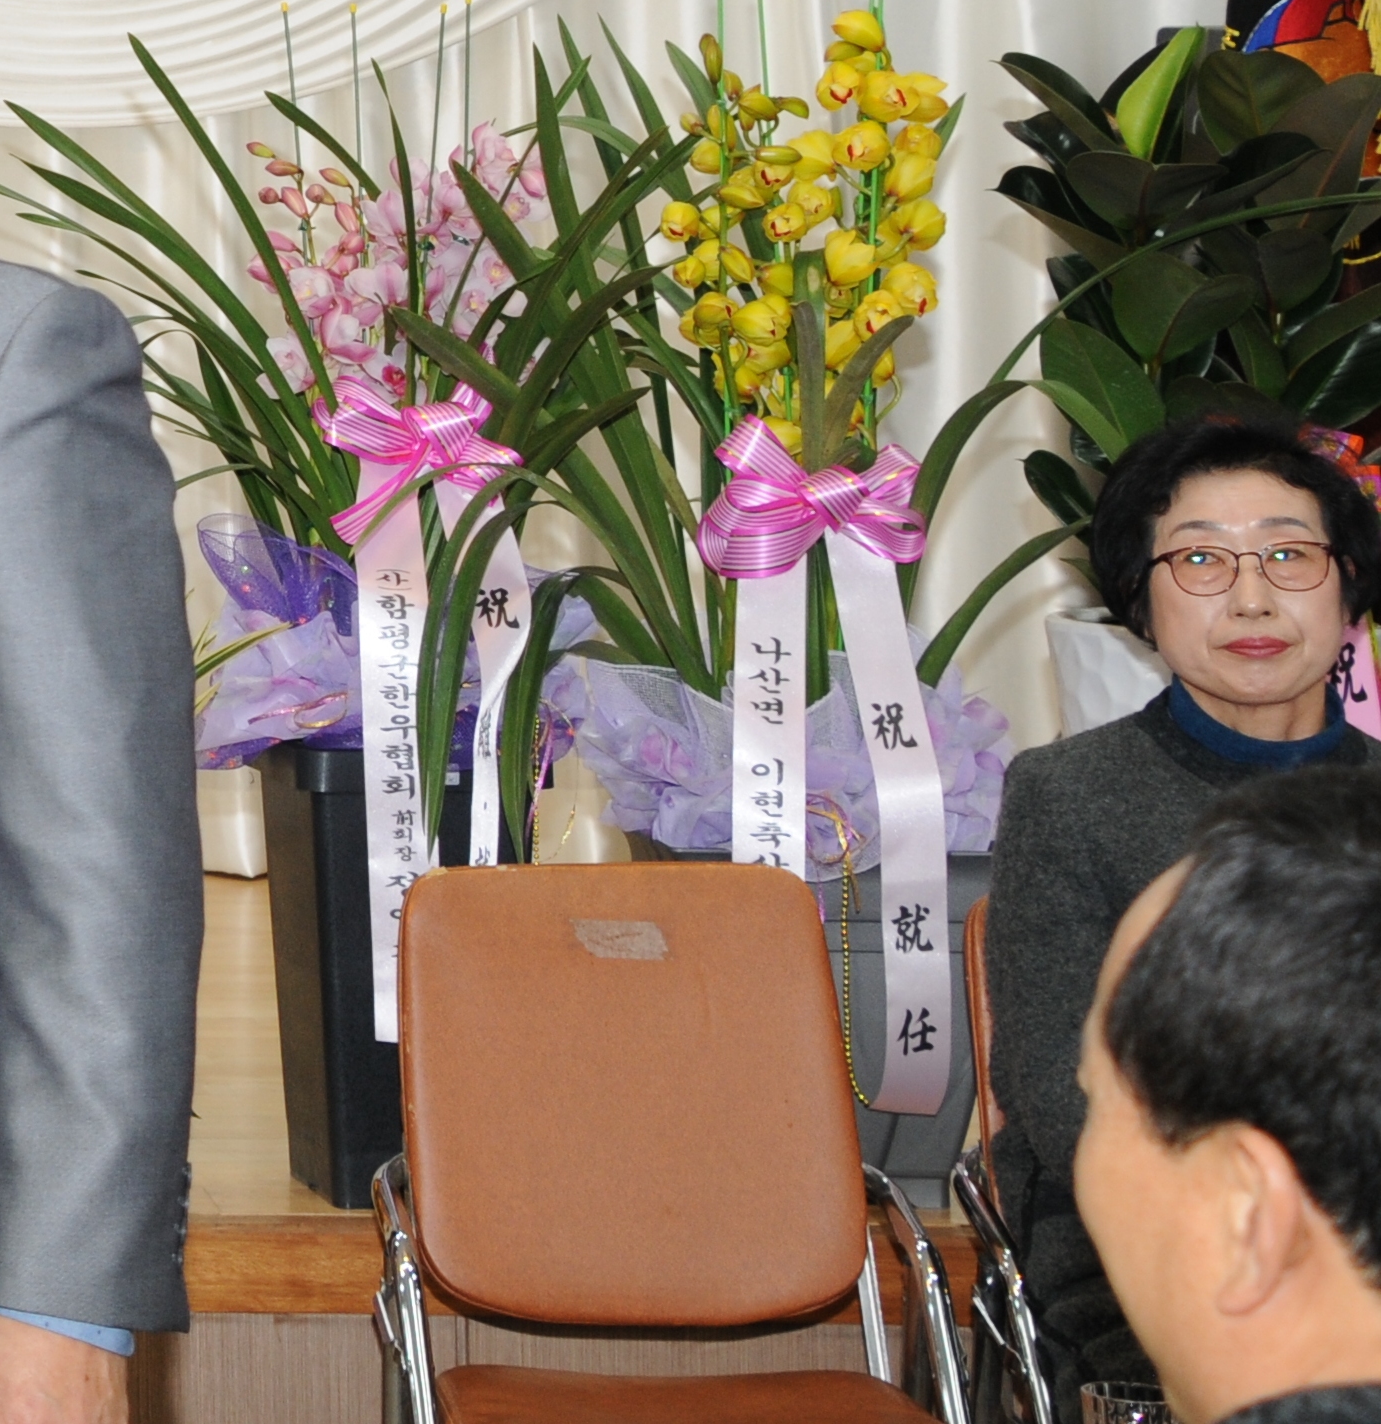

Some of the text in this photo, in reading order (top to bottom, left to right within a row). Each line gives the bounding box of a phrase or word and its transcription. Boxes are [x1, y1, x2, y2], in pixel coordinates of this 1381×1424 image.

[476, 588, 520, 629] 祝
[748, 637, 793, 726] 나산면
[871, 702, 919, 751] 祝
